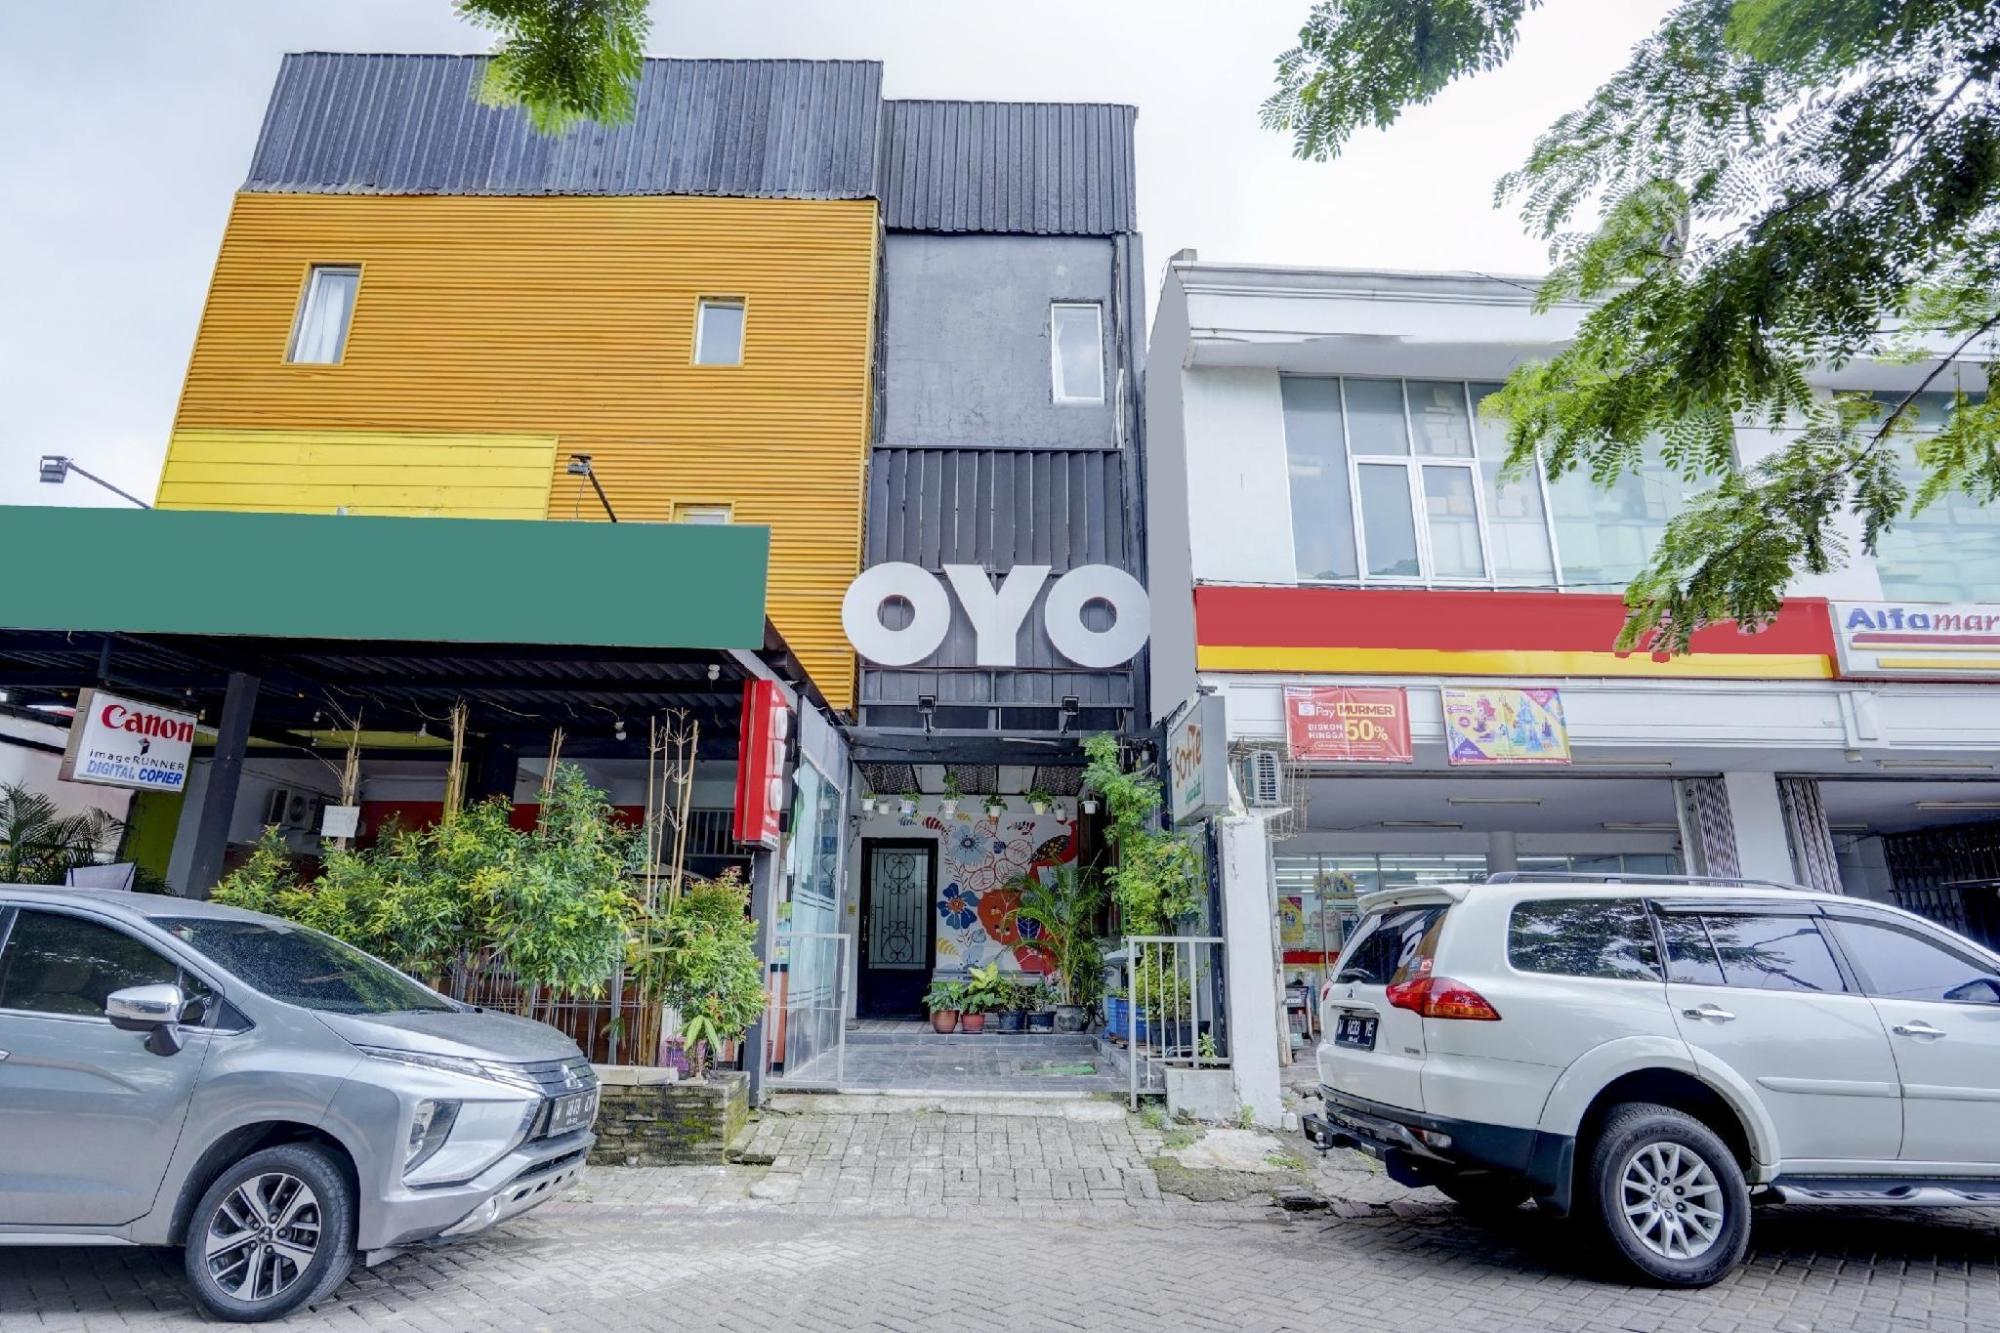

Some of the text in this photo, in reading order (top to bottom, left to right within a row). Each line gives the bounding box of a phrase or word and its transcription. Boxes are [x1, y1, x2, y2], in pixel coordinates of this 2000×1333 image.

[842, 561, 1150, 668] OYO
[1316, 705, 1392, 718] Pay MURMER
[101, 704, 194, 743] Canon
[1308, 719, 1389, 741] DISKON 50%
[1308, 731, 1345, 739] HINGGA
[89, 749, 185, 771] imageRUNNER
[86, 759, 183, 785] DIGITAL COPIER
